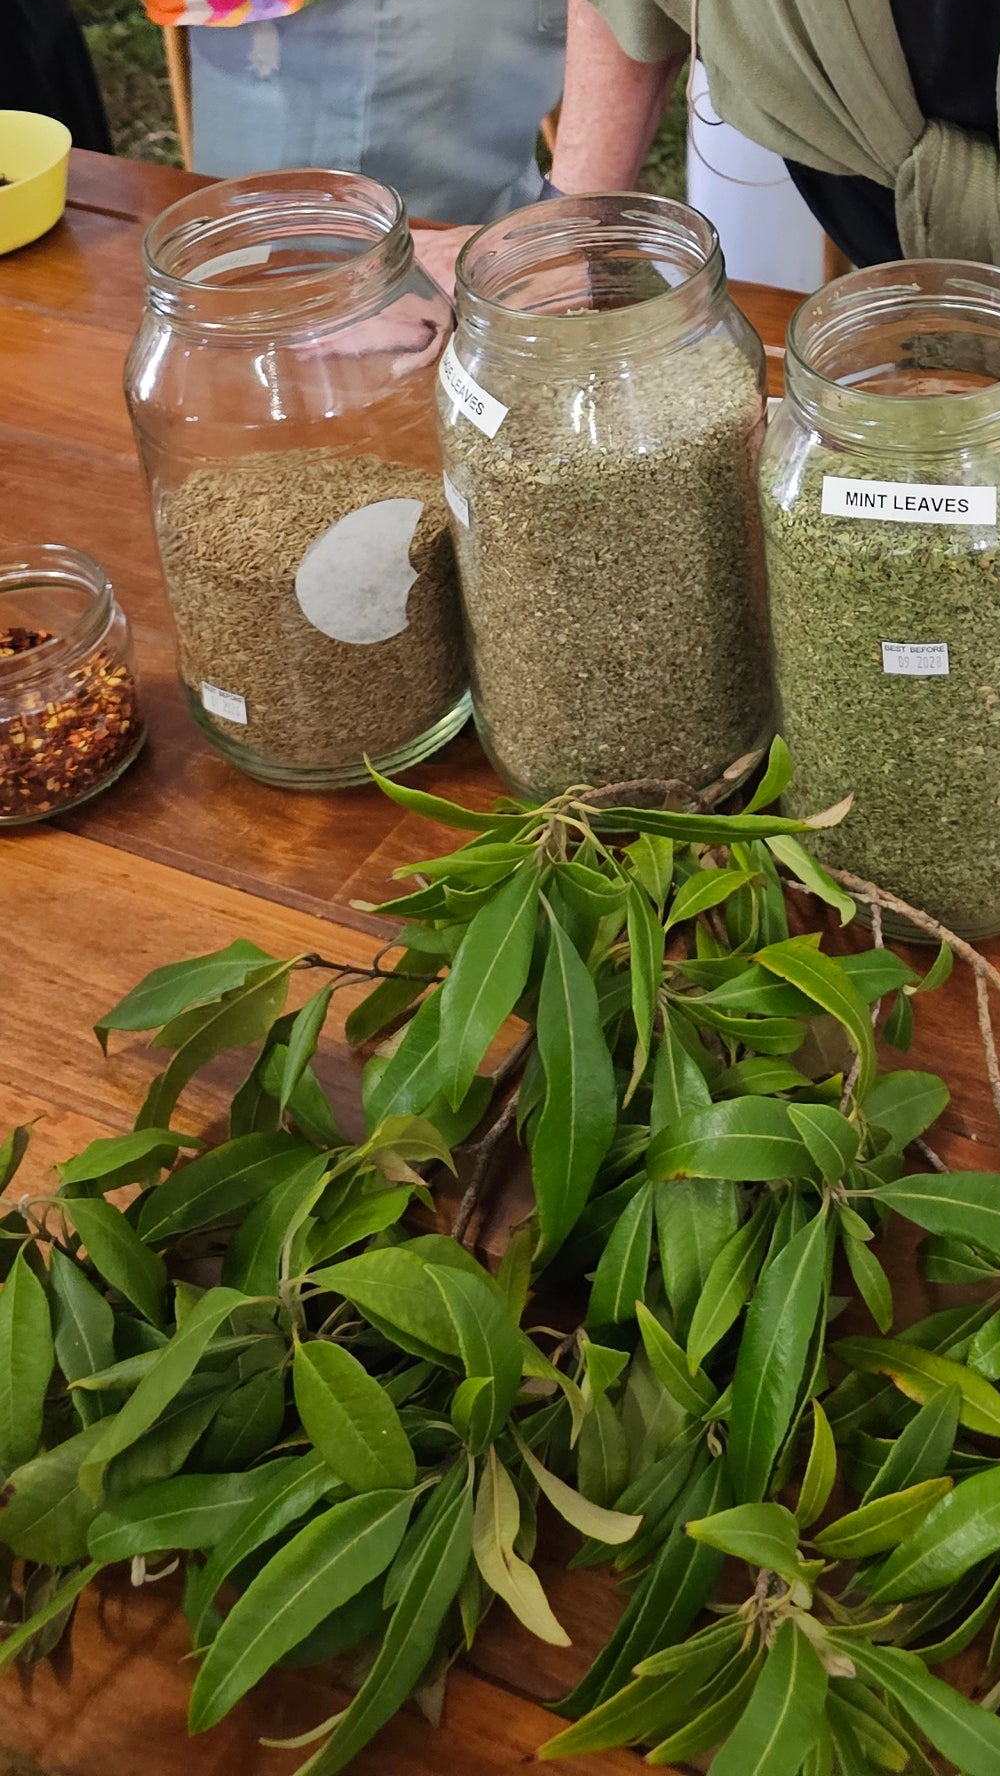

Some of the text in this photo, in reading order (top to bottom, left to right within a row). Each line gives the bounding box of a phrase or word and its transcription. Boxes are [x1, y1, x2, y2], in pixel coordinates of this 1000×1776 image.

[451, 375, 485, 416] LEAVES
[845, 491, 970, 513] MINT LEAVES
[910, 645, 945, 653] BEFORE
